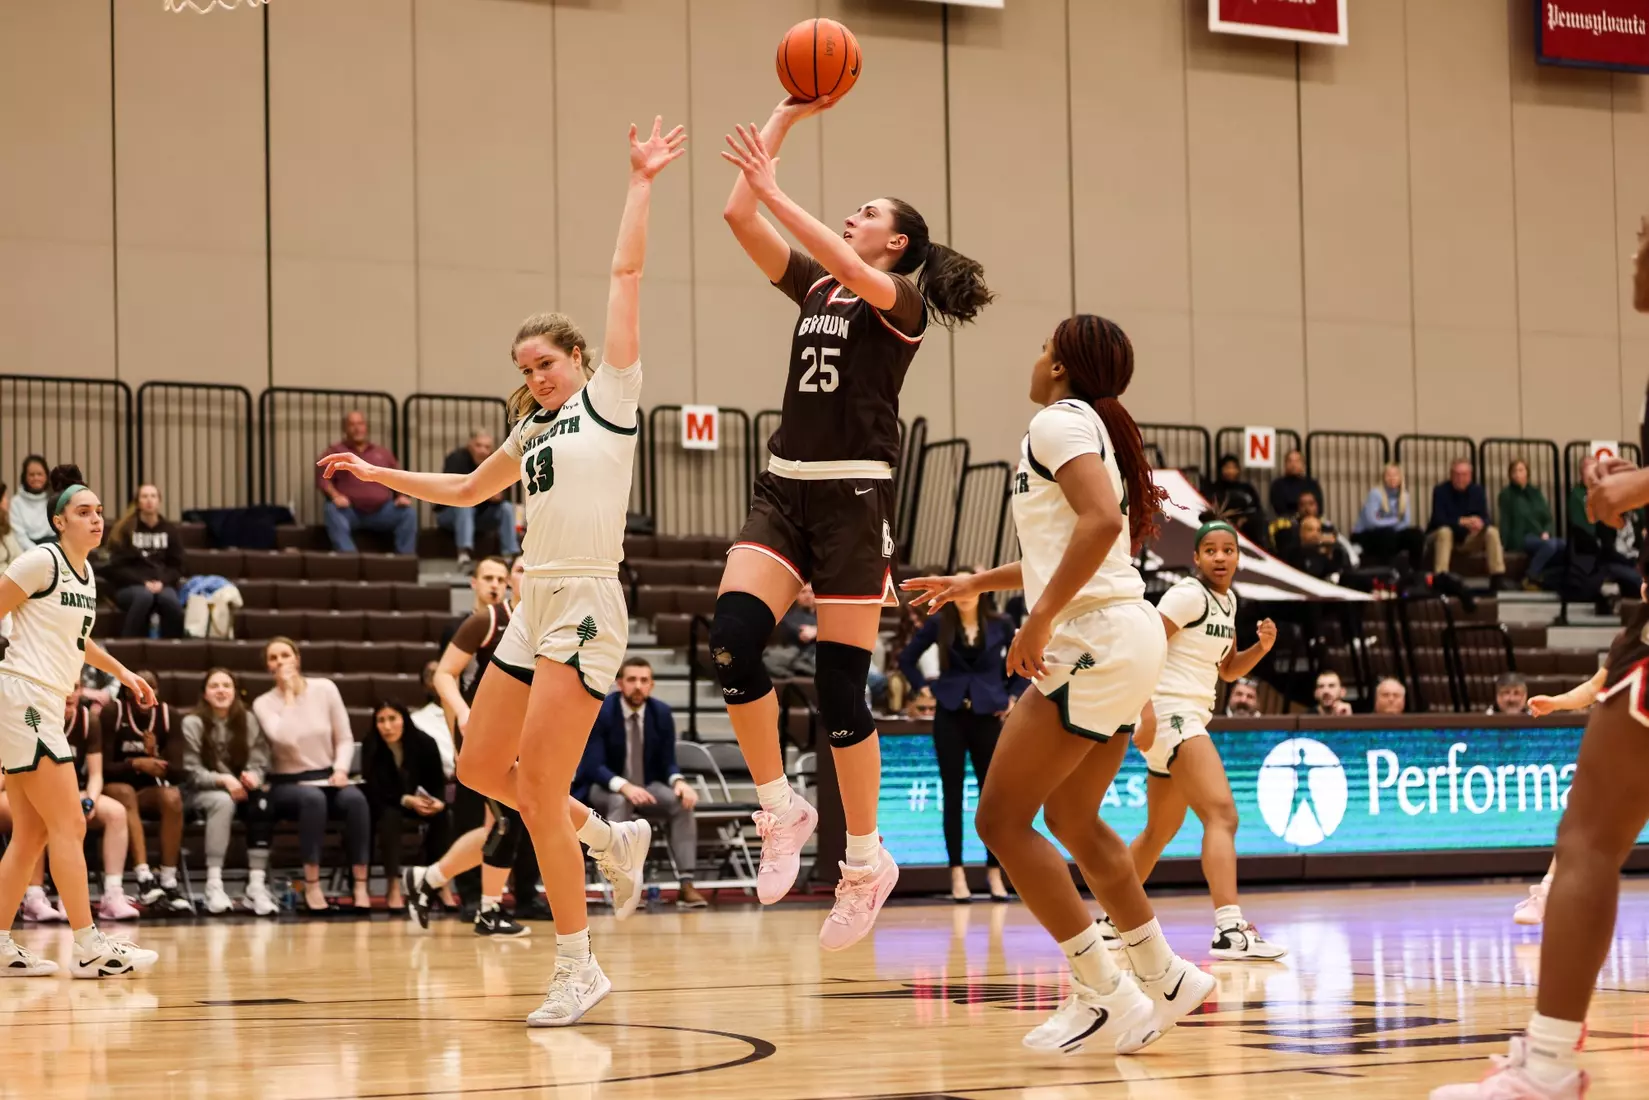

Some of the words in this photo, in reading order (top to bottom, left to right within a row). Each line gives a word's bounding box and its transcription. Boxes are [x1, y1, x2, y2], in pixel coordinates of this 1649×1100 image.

[1547, 2, 1646, 36] Pennsylvania
[799, 346, 841, 392] 25
[686, 412, 714, 442] M
[1250, 433, 1270, 461] N
[525, 445, 555, 496] 13
[1366, 742, 1578, 816] Performa
